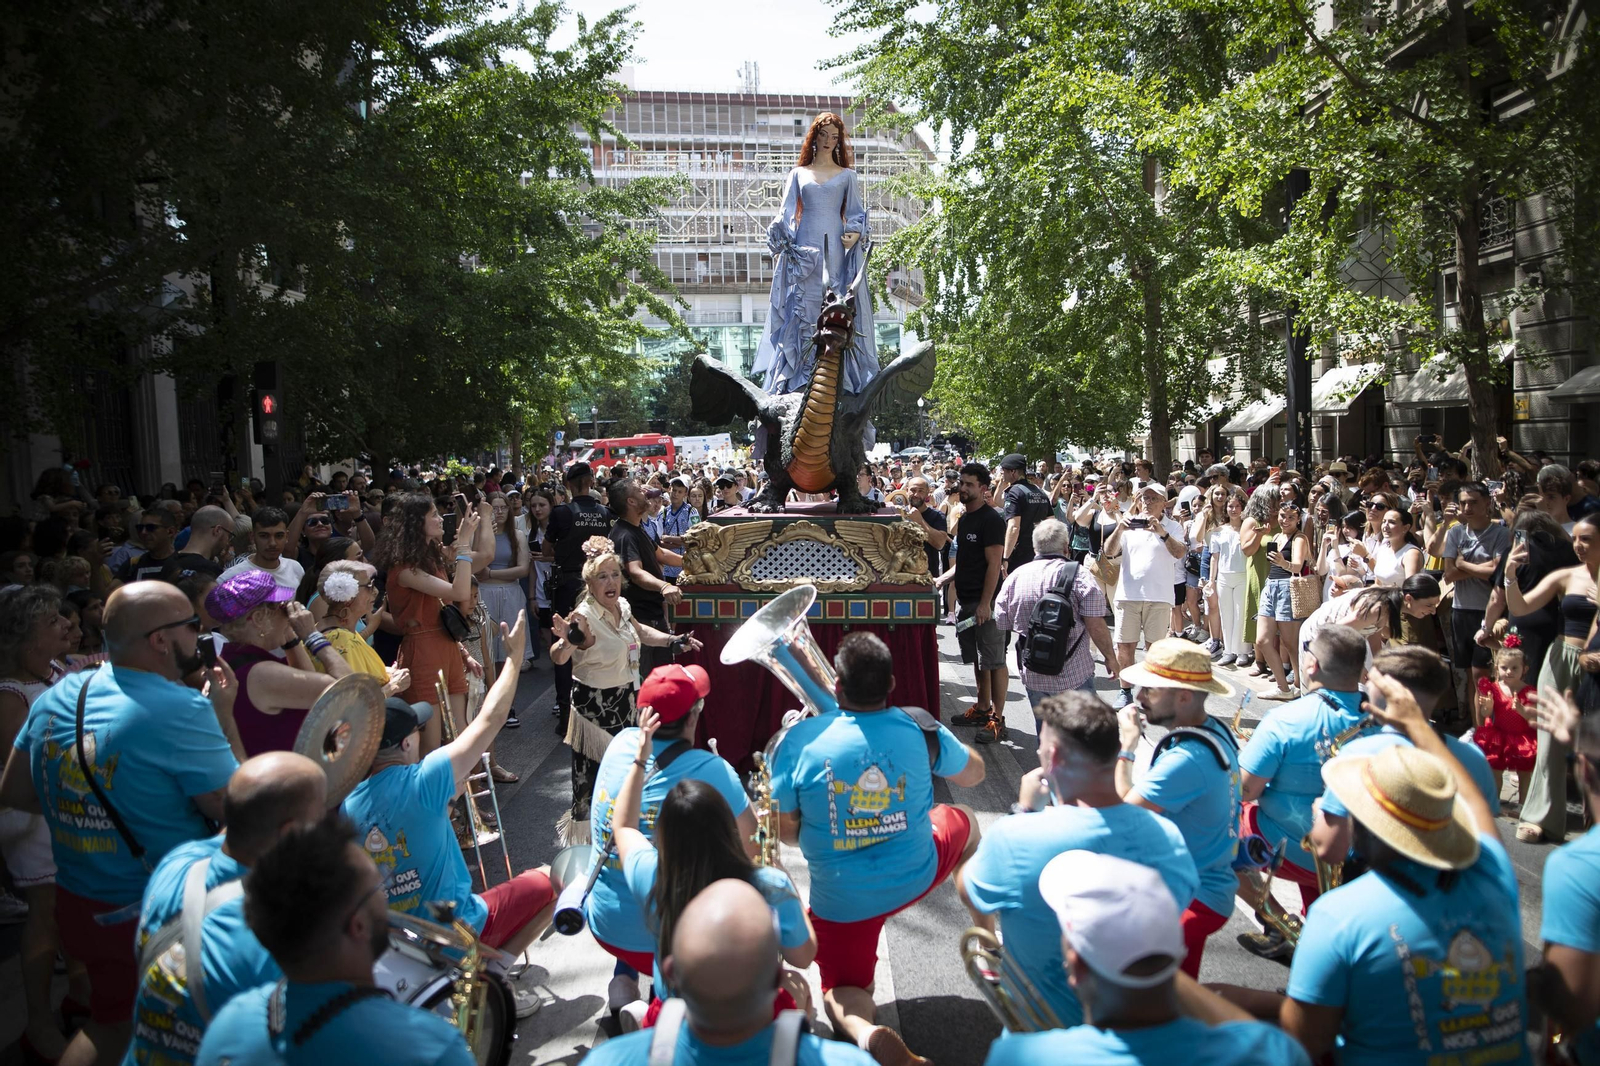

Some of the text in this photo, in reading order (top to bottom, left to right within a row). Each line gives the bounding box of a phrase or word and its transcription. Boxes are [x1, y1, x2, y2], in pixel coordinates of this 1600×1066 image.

[87, 804, 107, 818] QU
[845, 810, 907, 829] LLENA QUE
[845, 821, 907, 836] NOS VAMOS
[395, 869, 419, 884] QUE
[390, 879, 422, 896] VAMOS
